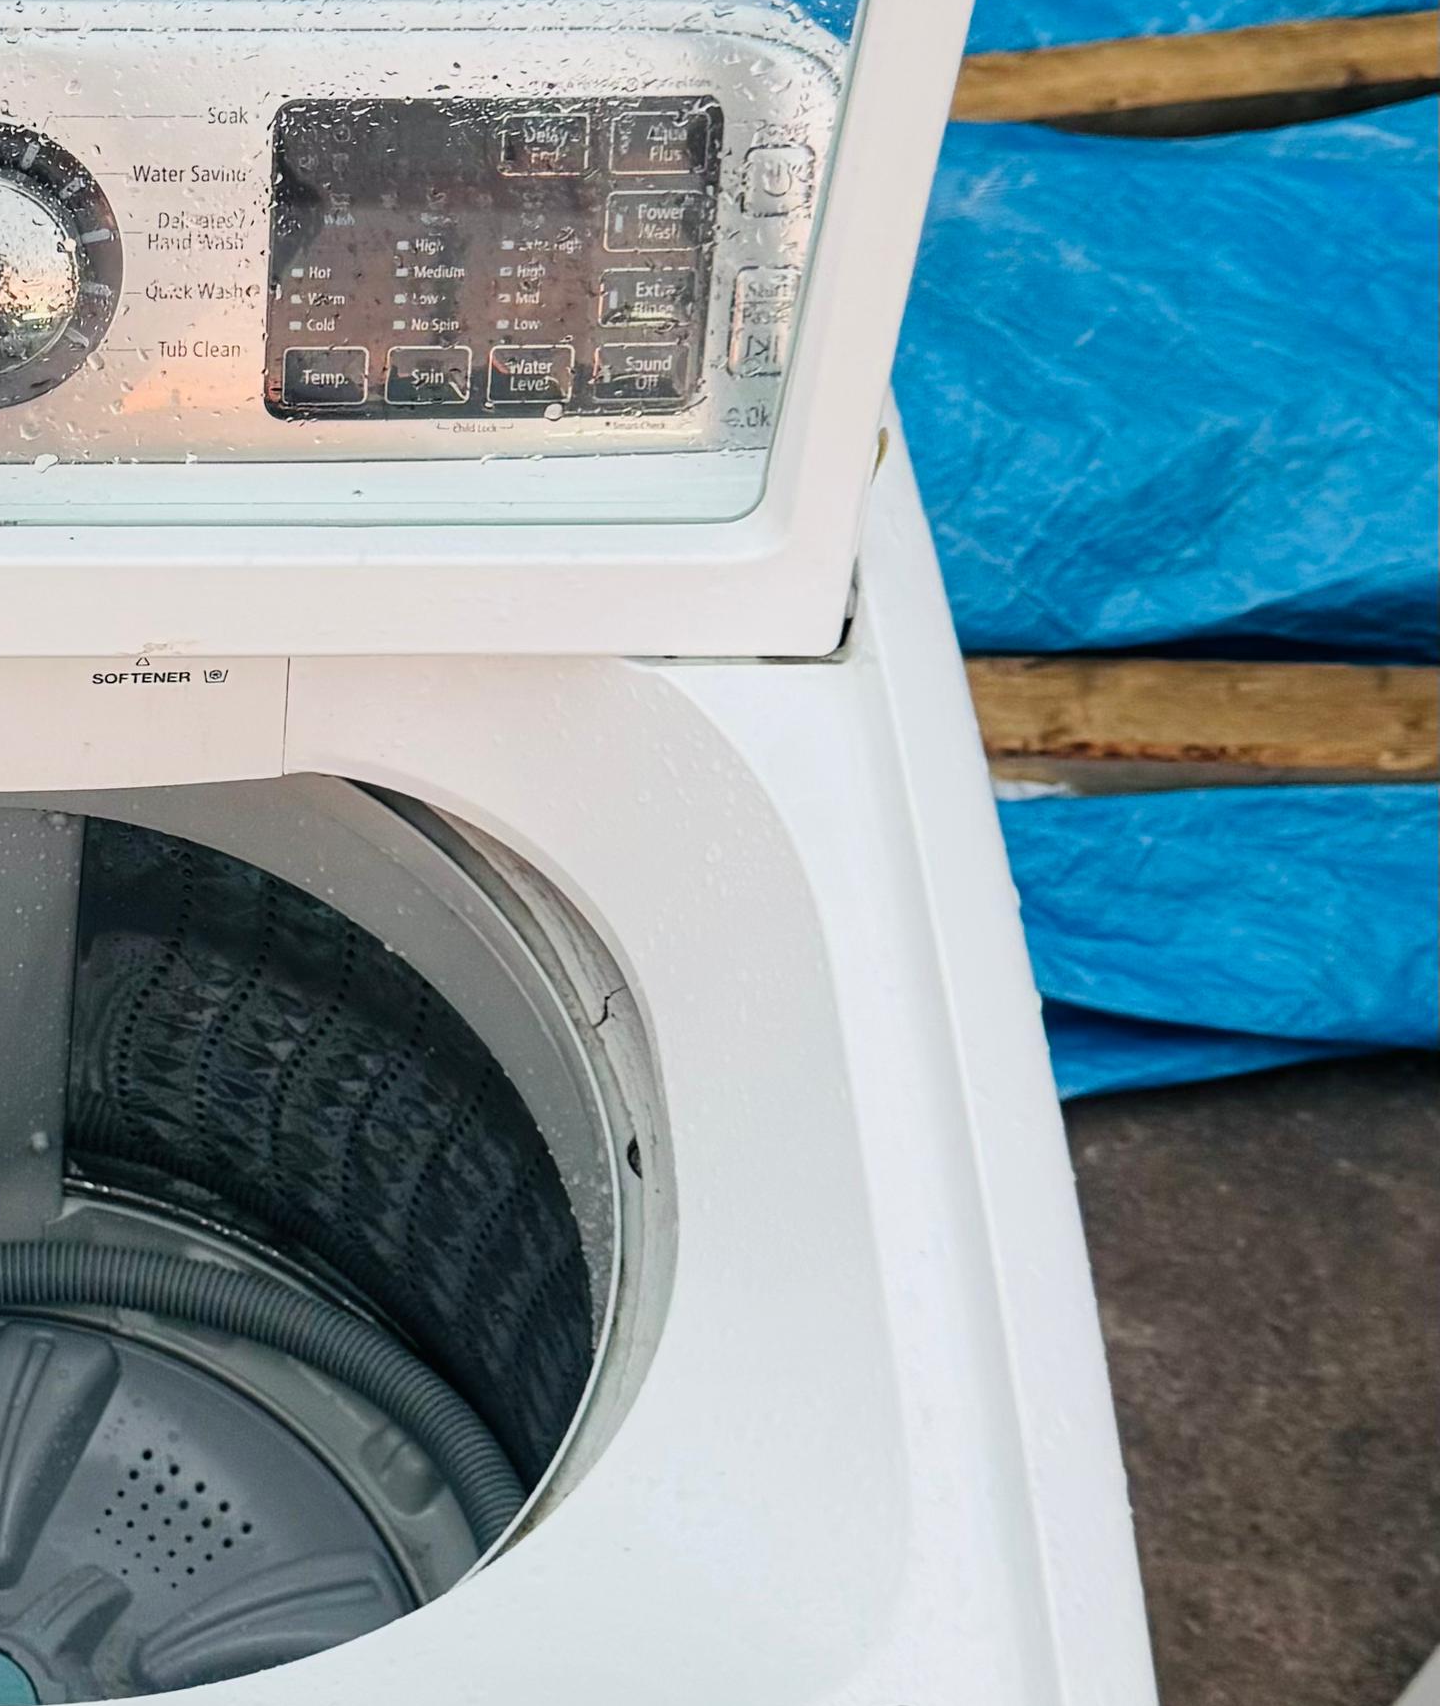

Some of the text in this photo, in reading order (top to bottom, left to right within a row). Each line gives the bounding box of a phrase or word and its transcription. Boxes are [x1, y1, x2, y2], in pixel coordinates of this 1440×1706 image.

[208, 106, 248, 124] Soak
[523, 121, 569, 146] Delay
[646, 124, 688, 145] Aqua
[649, 145, 683, 162] Plus
[133, 165, 247, 185] Water Saving
[158, 211, 245, 229] Delates/
[638, 204, 685, 220] Power
[639, 222, 681, 238] Wash
[148, 232, 244, 250] Hand Wash
[415, 239, 444, 255] High
[309, 267, 332, 278] Hot
[414, 266, 465, 278] Medium
[517, 265, 546, 278] High
[146, 281, 242, 301] Quick Wash
[413, 293, 439, 305] Low
[516, 292, 540, 304] Mid
[307, 319, 335, 331] Cold
[411, 319, 459, 333] No Spin
[514, 319, 539, 330] Low
[158, 341, 241, 358] Tub Clean
[510, 359, 552, 375] Water
[625, 355, 672, 372] Sound
[303, 370, 349, 388] Temp.
[412, 369, 444, 386] Spin
[510, 377, 550, 391] Level
[635, 375, 658, 390] Off
[92, 672, 191, 684] SOFTENER
